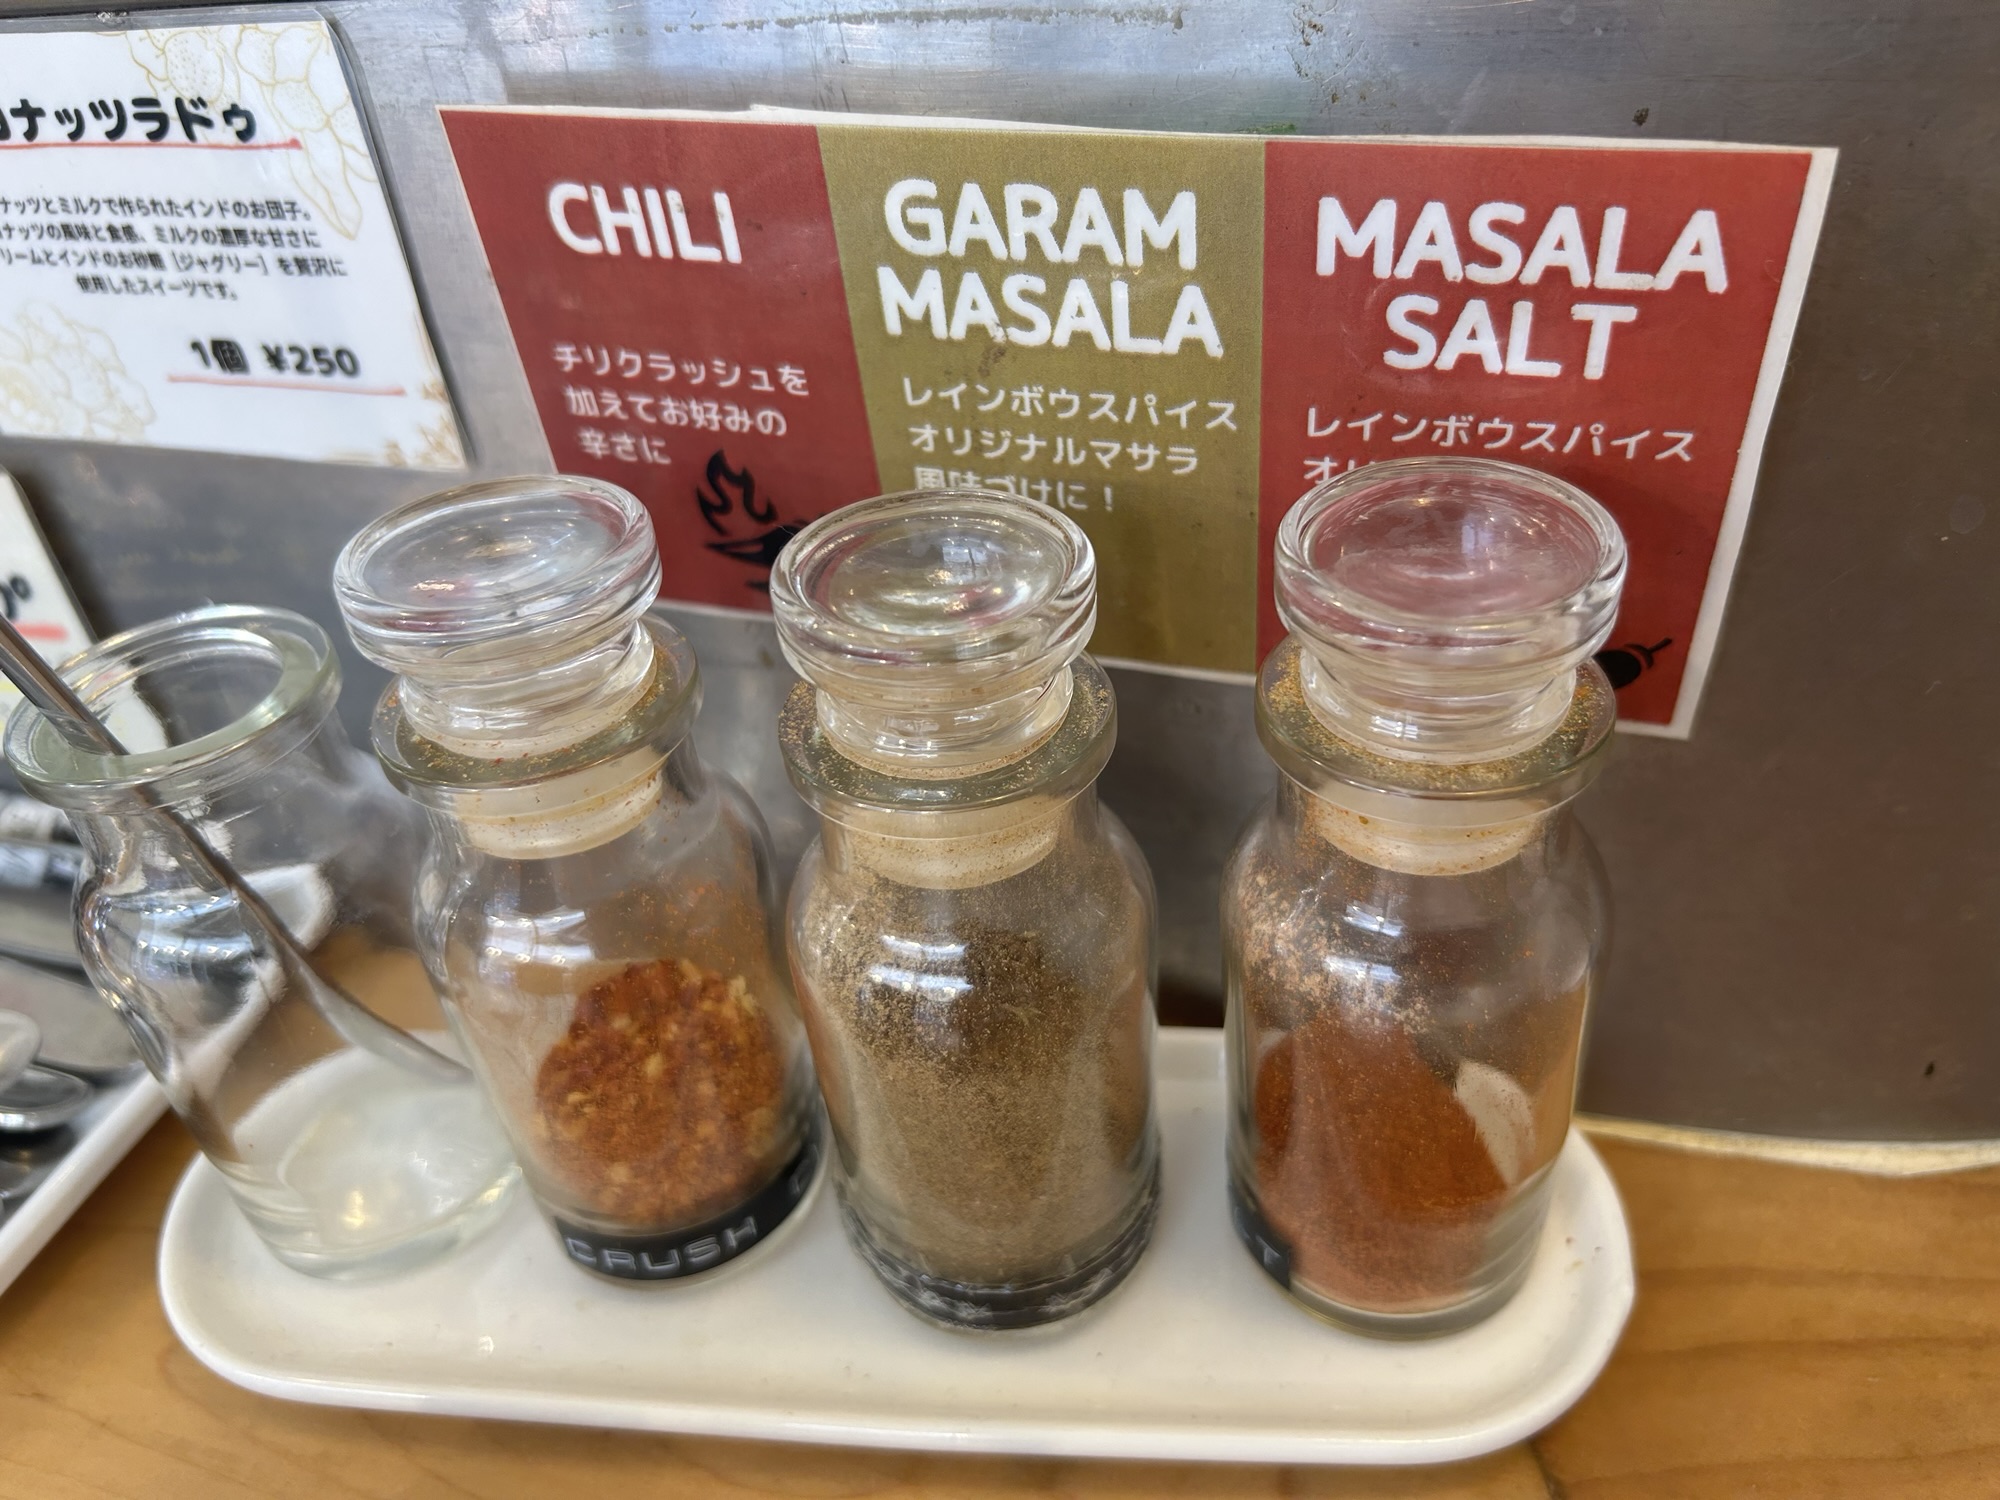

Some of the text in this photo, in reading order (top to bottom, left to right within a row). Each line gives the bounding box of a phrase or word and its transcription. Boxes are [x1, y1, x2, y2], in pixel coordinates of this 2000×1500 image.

[0, 96, 257, 143] ナッツラドゥ
[0, 223, 321, 248] ナッツの風味と食感、ミルクの濃厚な甘さに
[547, 181, 743, 265] CHILI
[884, 177, 1198, 271] GARAM
[1316, 195, 1728, 295] MASALA
[876, 265, 1224, 359] MASALA
[1383, 293, 1638, 382] SALT
[190, 339, 361, 379] 1個 ¥250
[552, 344, 809, 396] チリクラッシュを
[565, 386, 787, 436] 加えてお好みの
[902, 377, 1238, 432] レインボウスパイス
[578, 428, 671, 466] 辛さに
[908, 422, 1199, 476] オリジナルマサラ
[1306, 407, 1695, 463] レインボウスパイス
[566, 1216, 757, 1271] CRUSH
